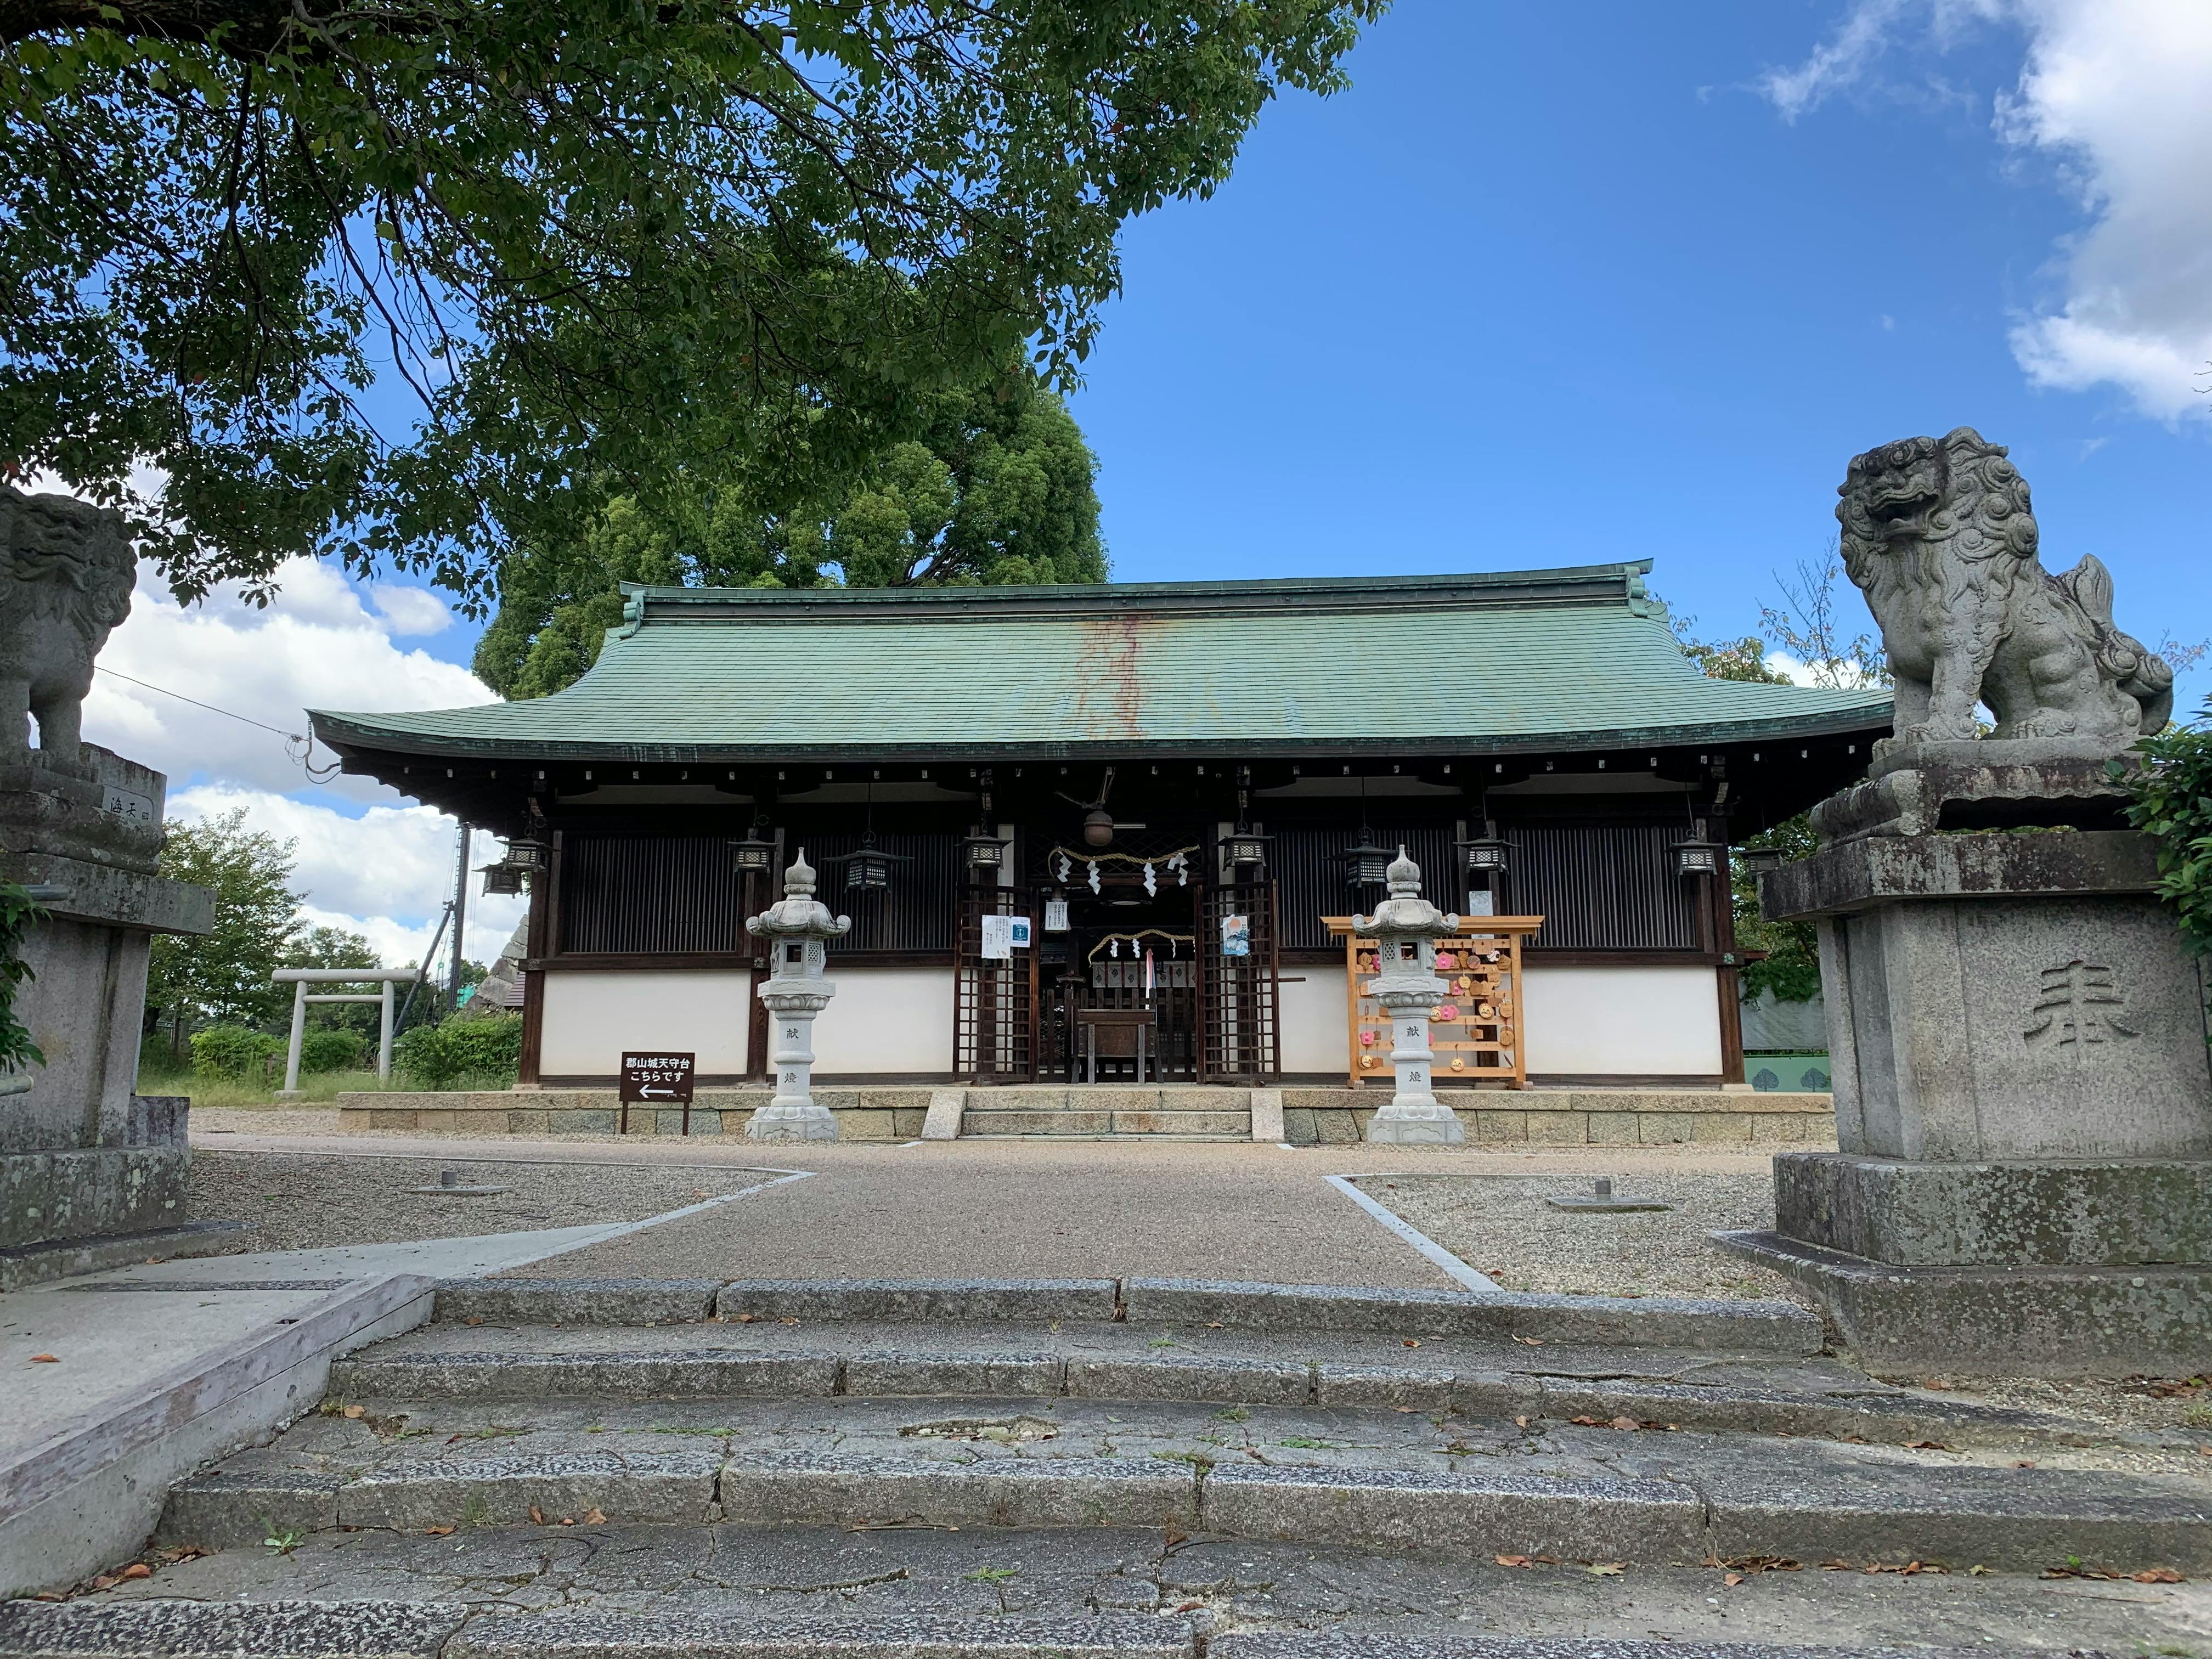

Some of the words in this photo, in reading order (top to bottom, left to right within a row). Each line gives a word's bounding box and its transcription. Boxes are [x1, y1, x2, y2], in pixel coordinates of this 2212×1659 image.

[2023, 959, 2141, 1064] 奉
[625, 1057, 690, 1069] 郡山城天守台
[630, 1070, 685, 1082] こちらです
